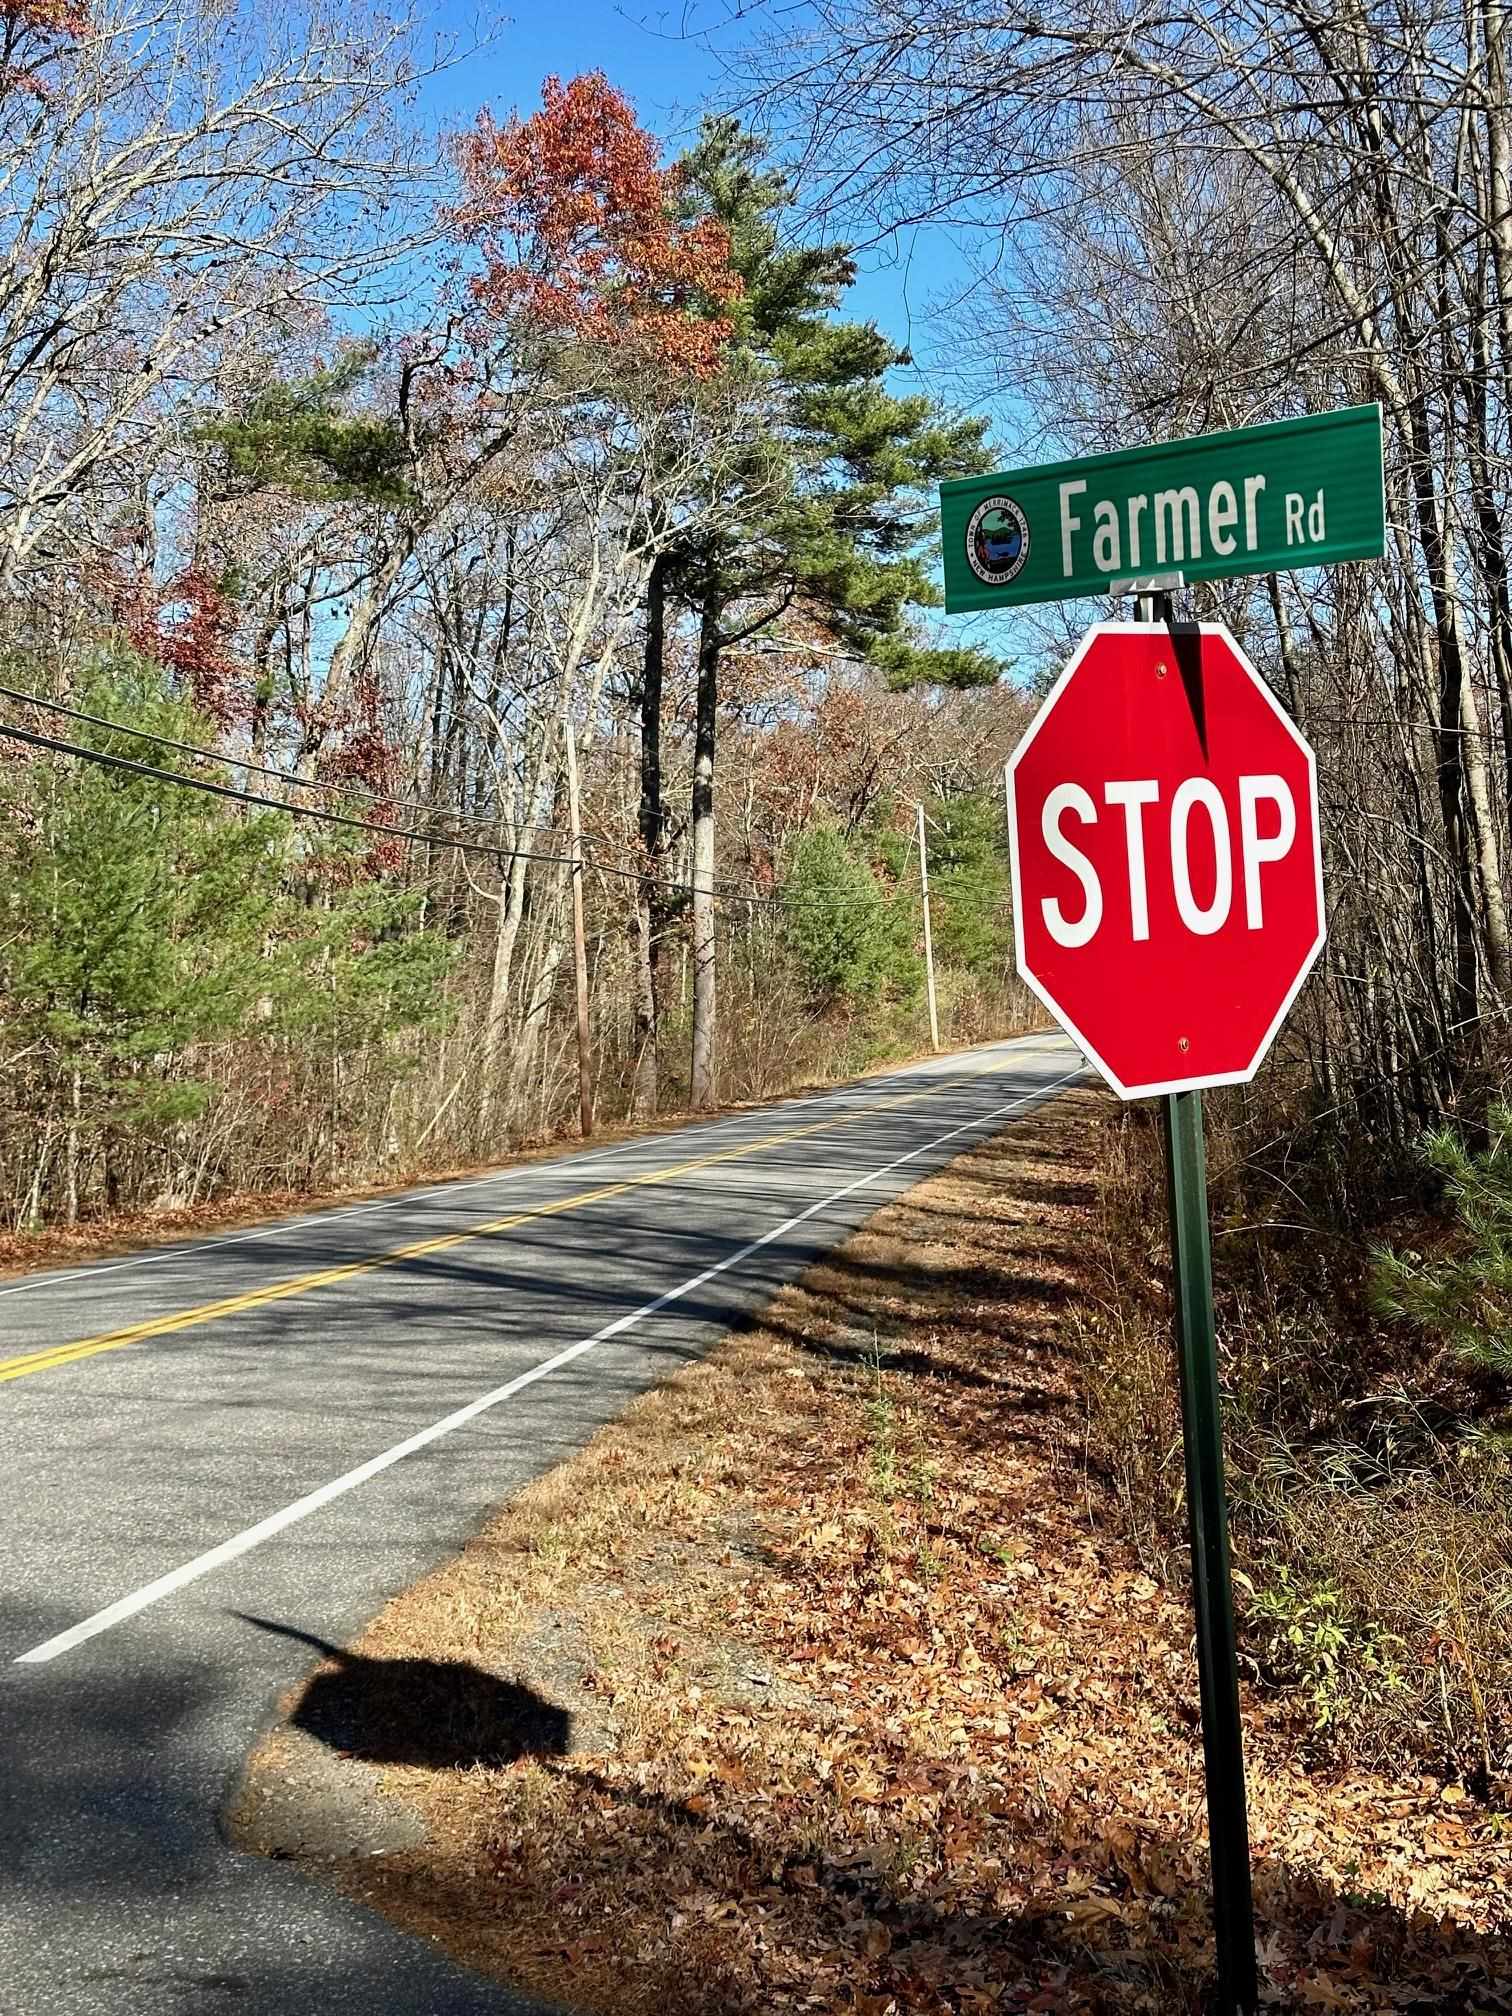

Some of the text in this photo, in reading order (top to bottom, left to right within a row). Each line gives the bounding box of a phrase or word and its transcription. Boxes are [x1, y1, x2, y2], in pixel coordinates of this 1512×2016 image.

[972, 552, 1027, 583] NEW HAMPSHIRE
[1059, 474, 1326, 577] Farmer Rd
[1041, 774, 1297, 948] STOP
